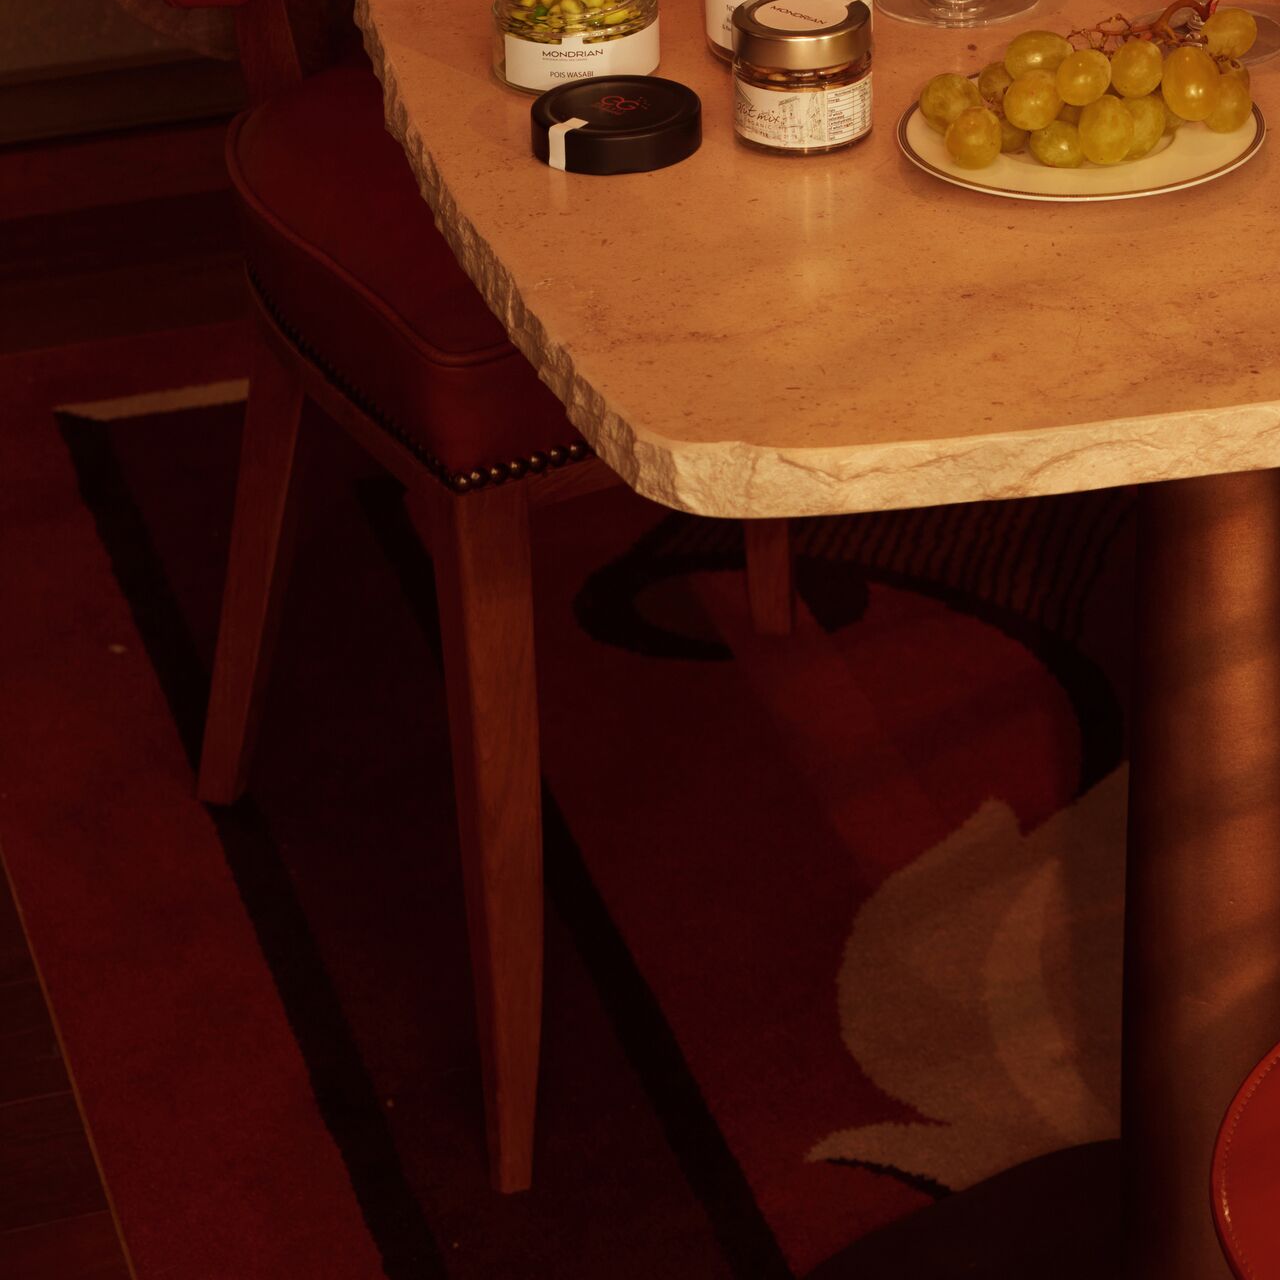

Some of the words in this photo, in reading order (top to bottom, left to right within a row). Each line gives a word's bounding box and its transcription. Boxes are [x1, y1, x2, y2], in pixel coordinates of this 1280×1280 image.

[770, 4, 829, 25] MONDRIAN
[541, 48, 604, 59] MONDRIAN
[549, 71, 566, 79] POIS
[566, 70, 594, 79] WASABI
